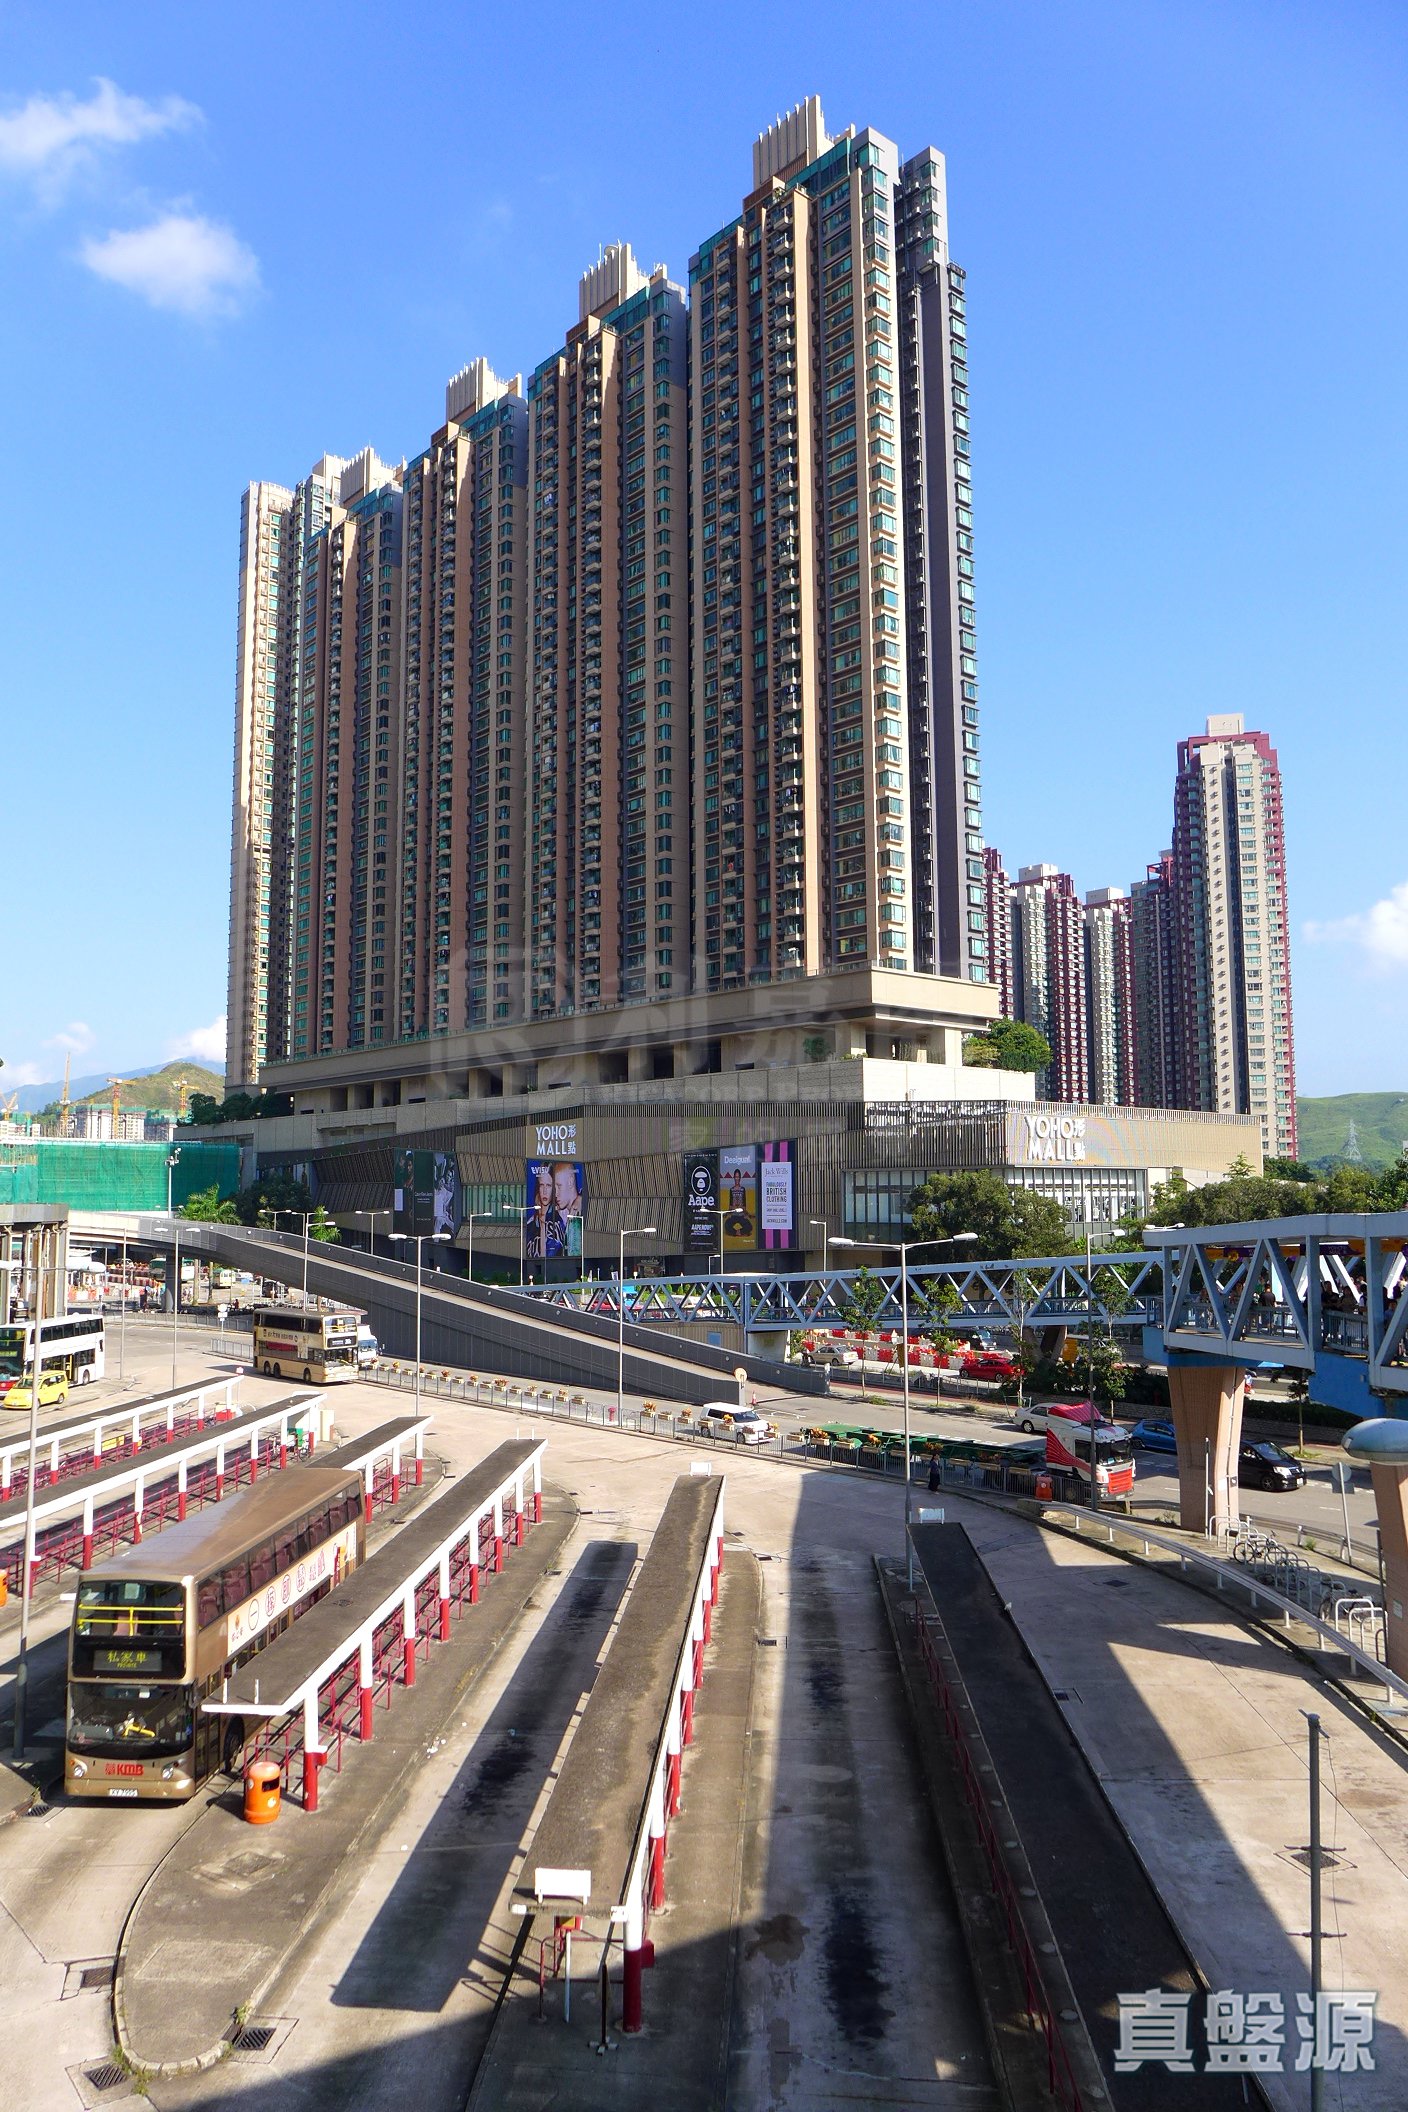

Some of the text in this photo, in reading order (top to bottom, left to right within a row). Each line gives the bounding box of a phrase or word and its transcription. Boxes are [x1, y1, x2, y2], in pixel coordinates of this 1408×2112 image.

[536, 1125, 568, 1141] YOHO
[1024, 1116, 1073, 1139] YOHO
[536, 1141, 567, 1156] MALL
[1027, 1139, 1073, 1161] MALL
[765, 1167, 789, 1177] Jack Wills
[766, 1187, 787, 1196] BRITISH
[688, 1194, 715, 1208] Aape
[117, 1764, 144, 1775] KMB
